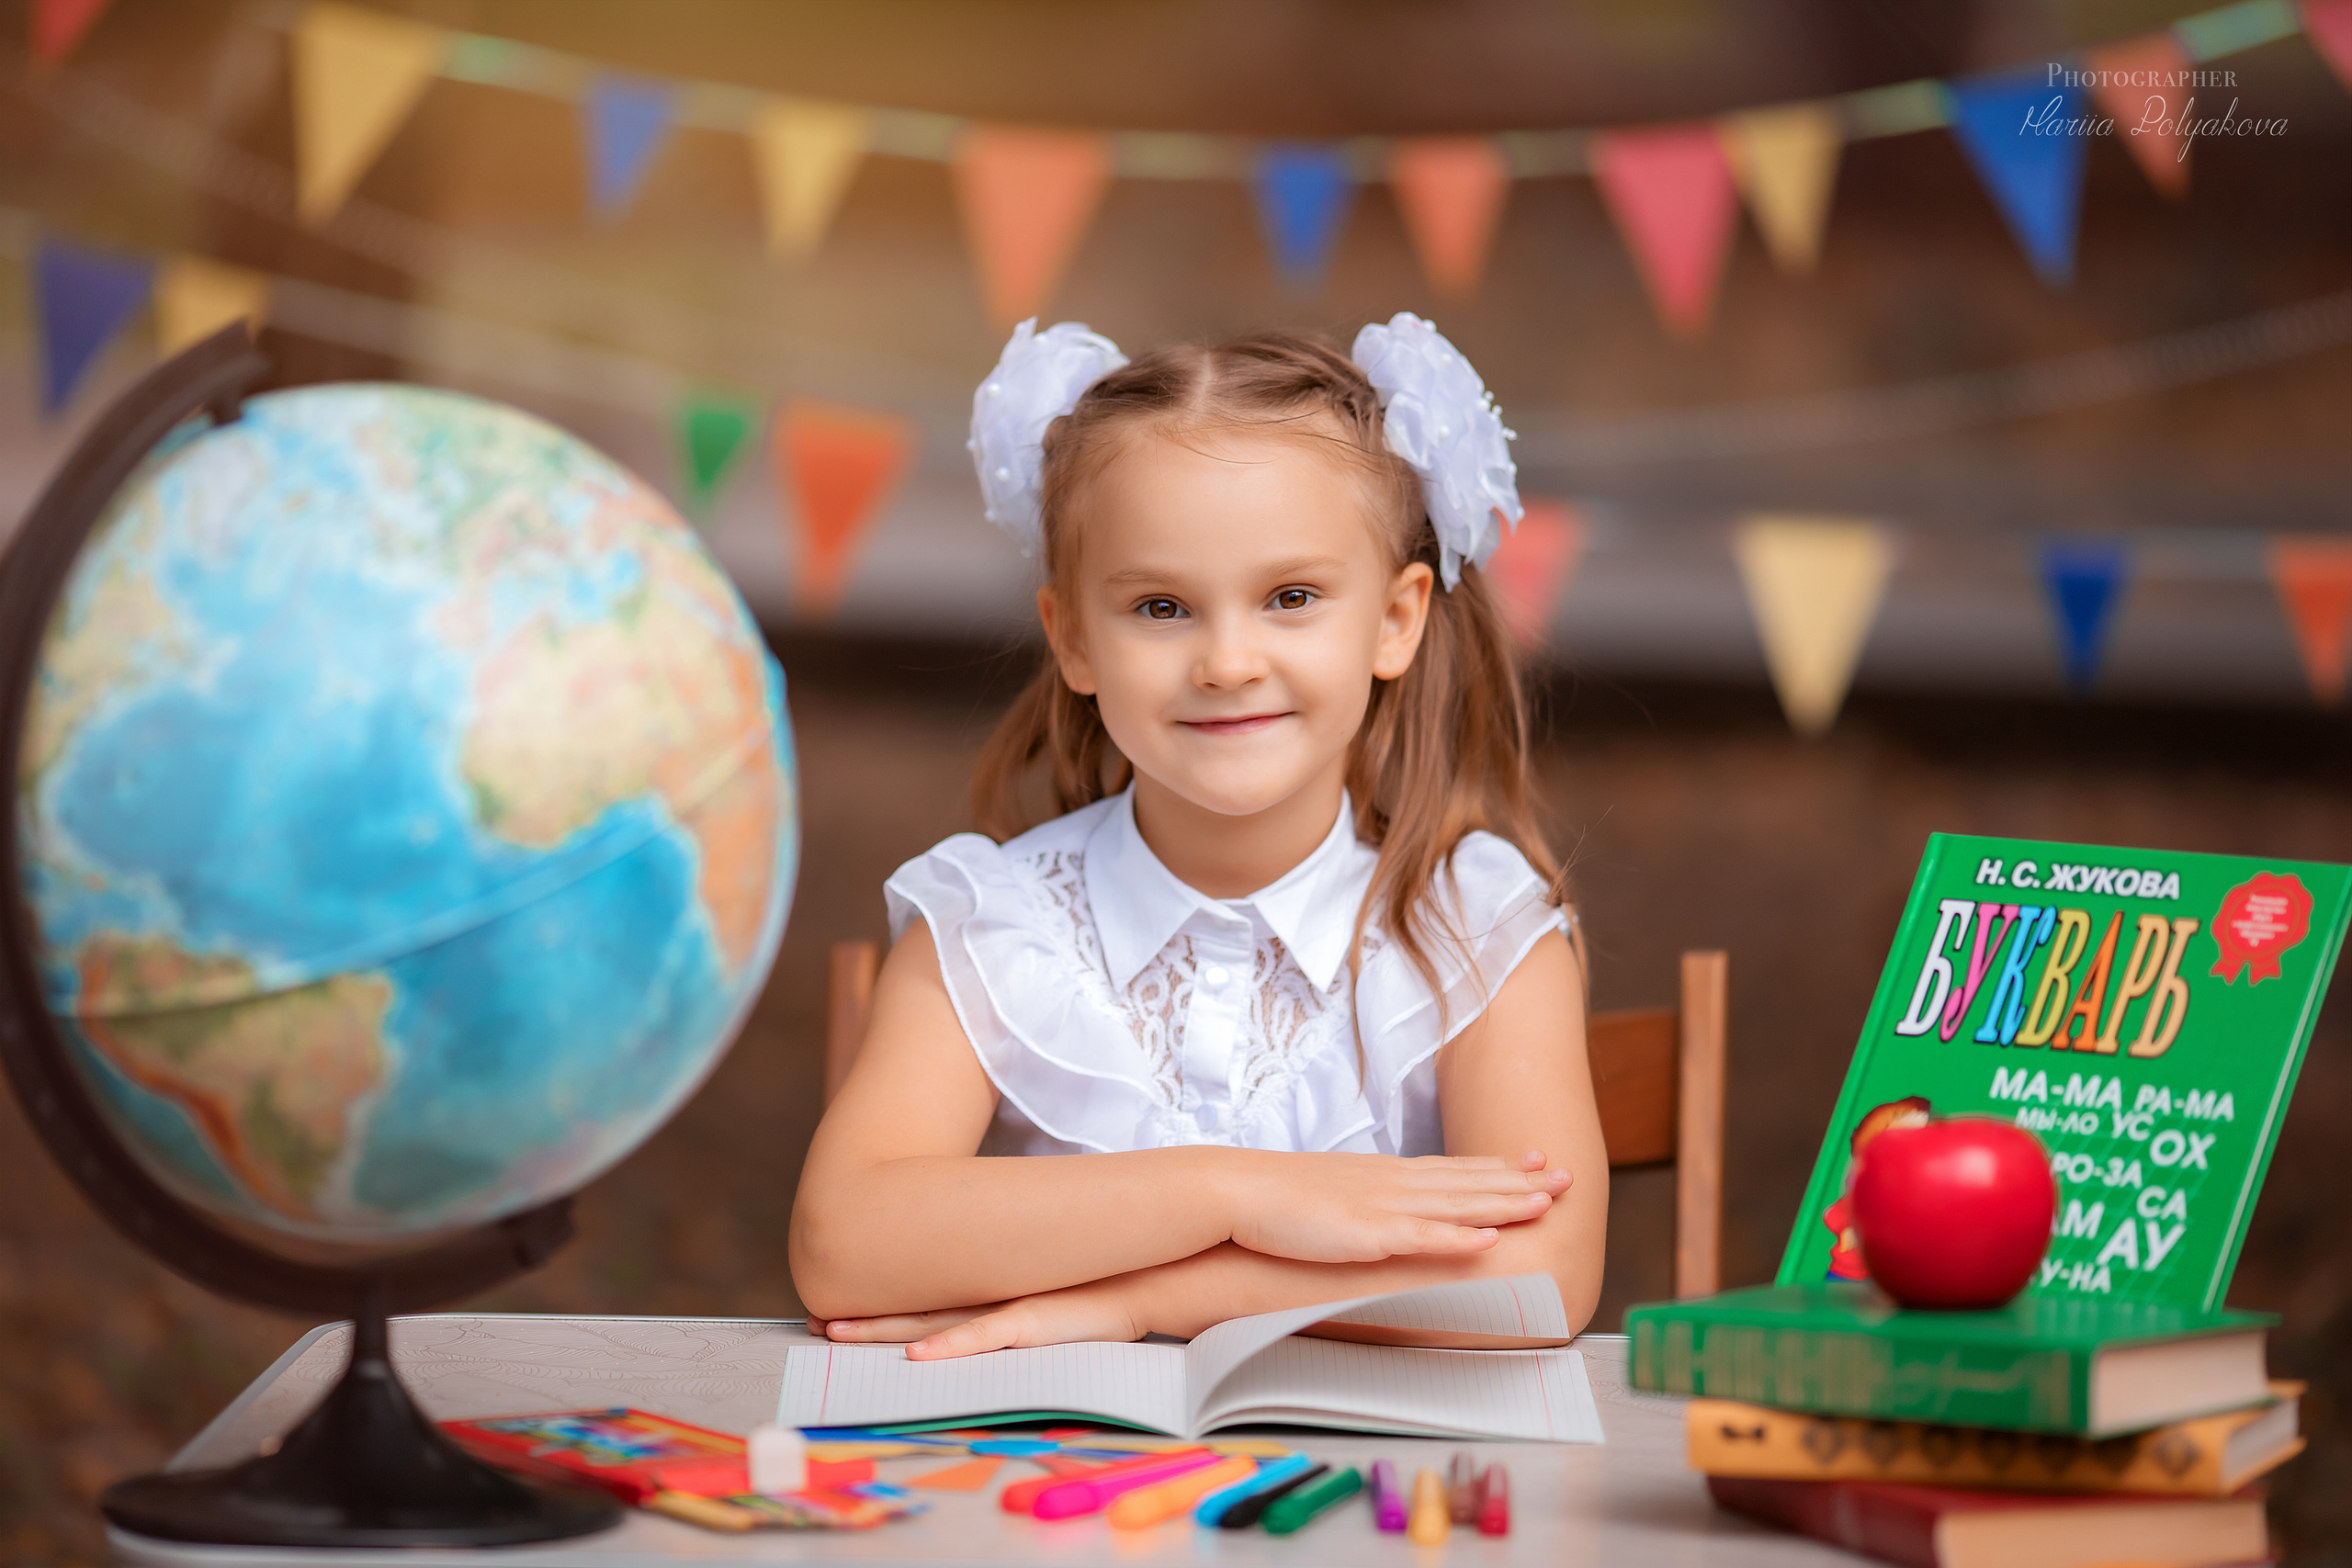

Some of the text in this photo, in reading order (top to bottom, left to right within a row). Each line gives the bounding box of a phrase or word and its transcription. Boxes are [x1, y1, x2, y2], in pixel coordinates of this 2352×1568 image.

[1975, 858, 2181, 900] Н. С. ЖУКОВА
[1894, 897, 2200, 1059] БУКВАРЬ
[1989, 1066, 2123, 1111] МА-МА
[2134, 1084, 2235, 1122] РА-МА
[2015, 1106, 2100, 1136] МЫ-ЛО
[2110, 1111, 2155, 1142] УС
[2149, 1129, 2217, 1171] ОХ
[2050, 1152, 2143, 1190] РО-ЗА
[2136, 1185, 2188, 1221] СА
[2096, 1217, 2187, 1271] АУ
